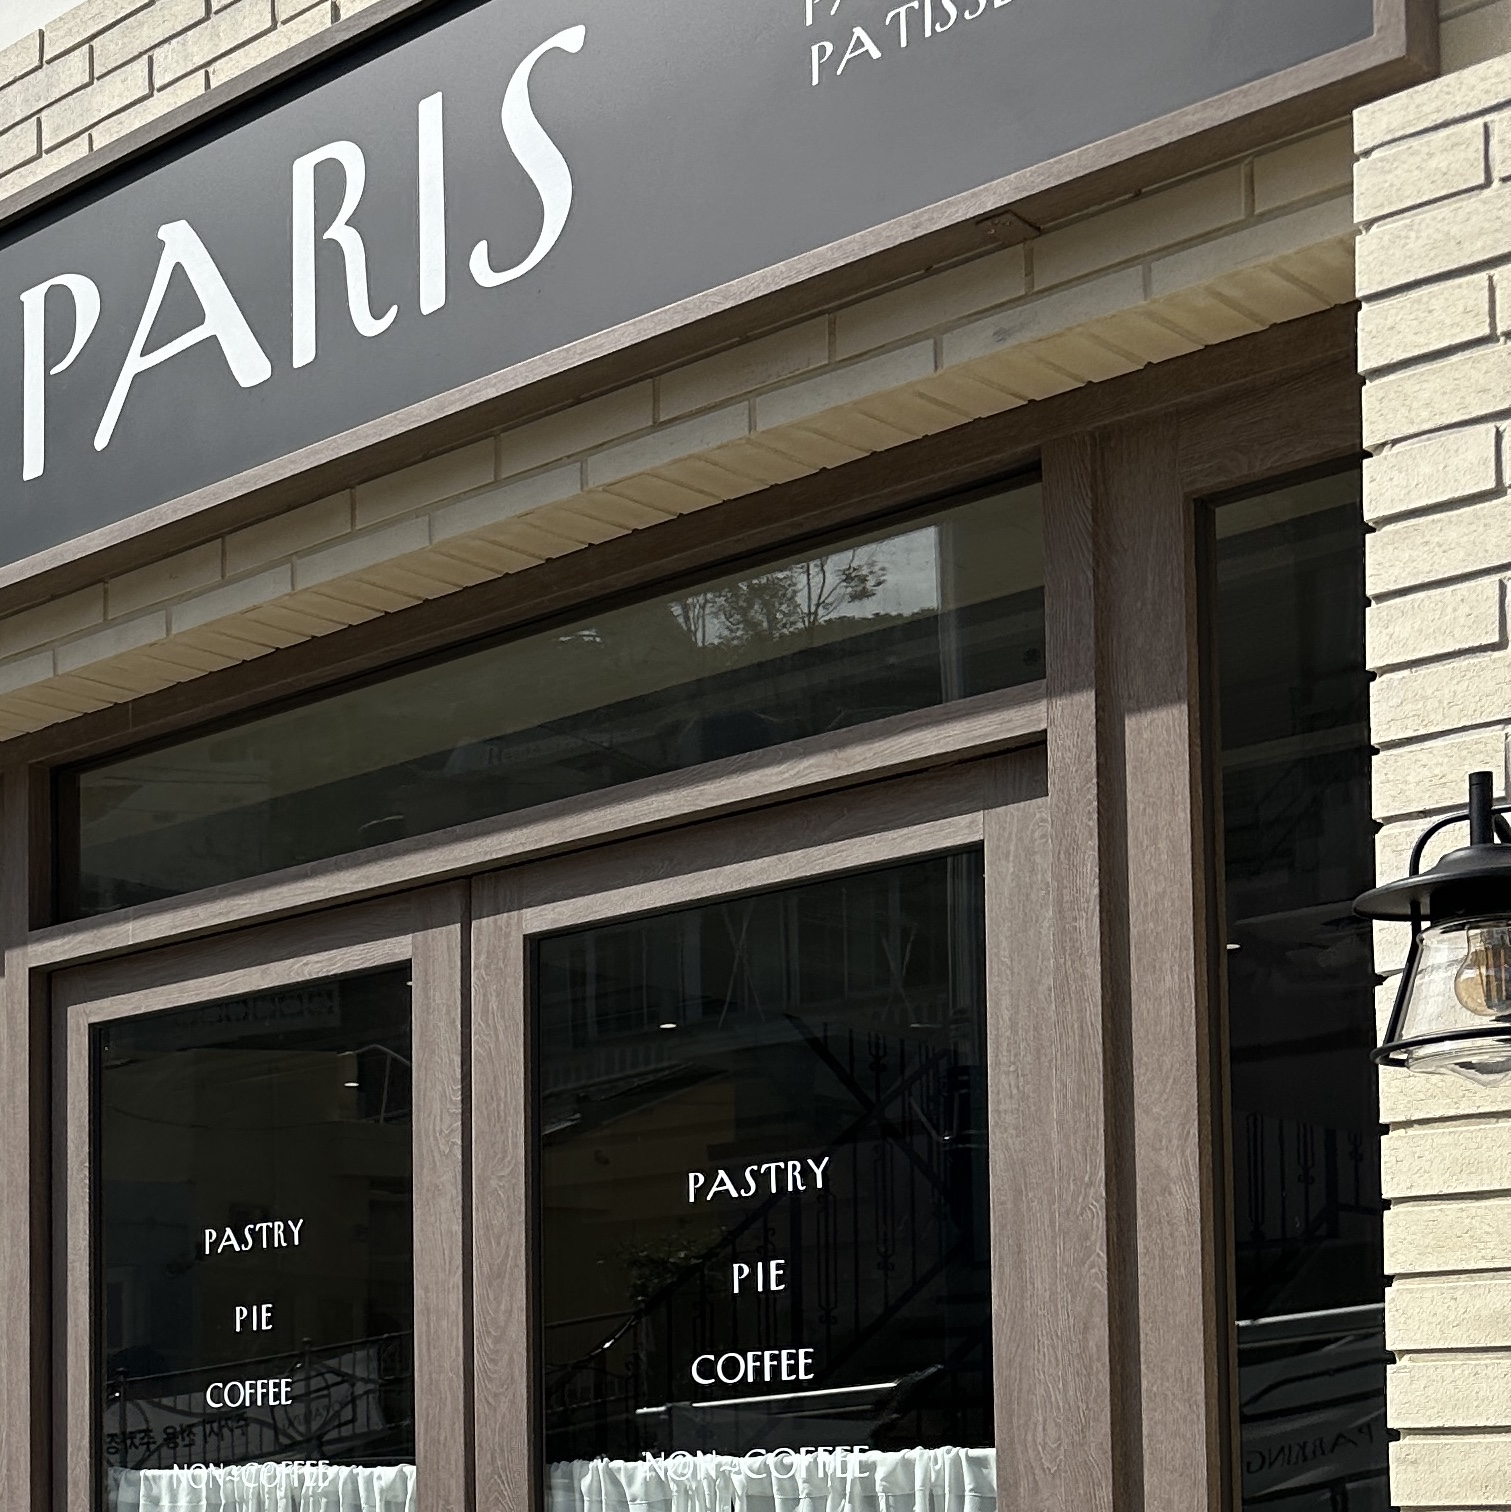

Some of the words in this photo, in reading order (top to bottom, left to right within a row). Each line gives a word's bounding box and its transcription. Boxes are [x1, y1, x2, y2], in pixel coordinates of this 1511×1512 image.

[811, 0, 1012, 86] PATIS
[20, 25, 585, 481] PARIS
[688, 1157, 829, 1202] PASTRY
[204, 1219, 303, 1254] PASTRY
[733, 1260, 785, 1293] PIE
[235, 1304, 272, 1332] PIE
[692, 1349, 814, 1384] COFFEE
[206, 1379, 292, 1407] COFFEE
